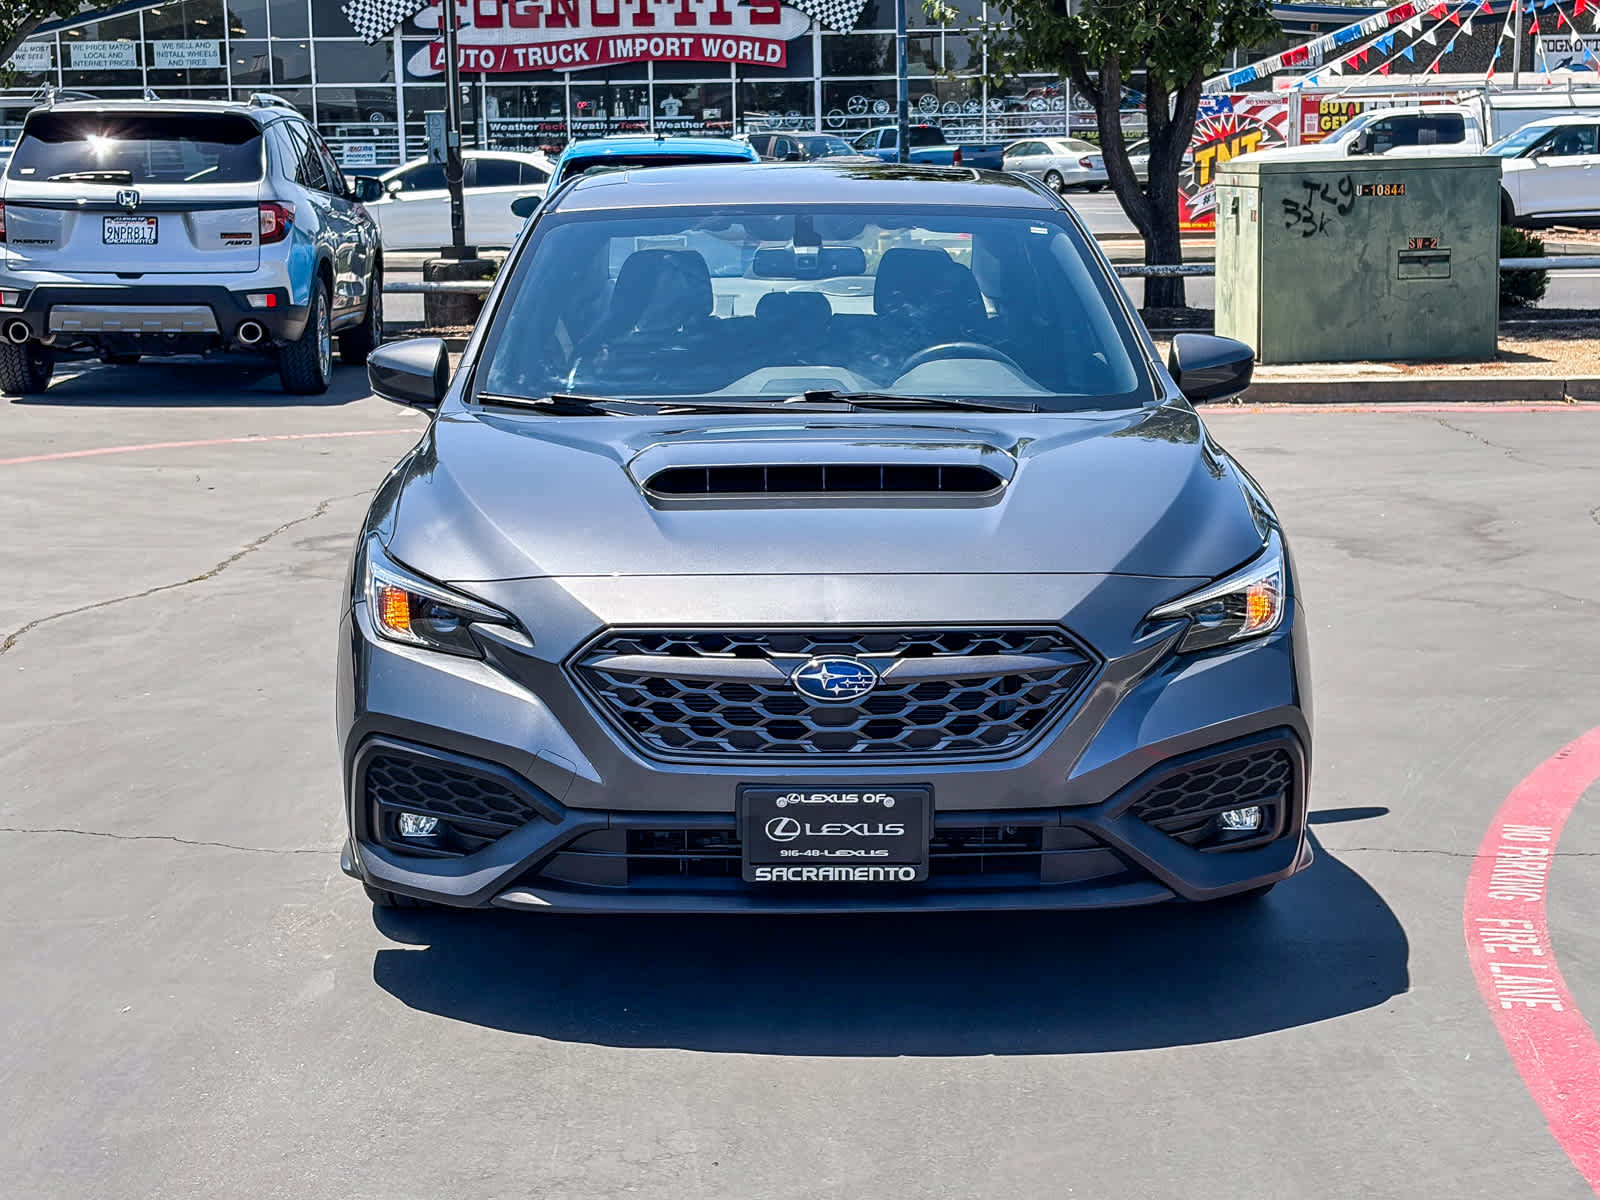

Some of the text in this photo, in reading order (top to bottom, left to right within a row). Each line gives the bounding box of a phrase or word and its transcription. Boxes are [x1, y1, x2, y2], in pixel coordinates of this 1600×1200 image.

[430, 0, 781, 29] OGNOTTIS
[108, 42, 134, 50] MATCH
[513, 42, 590, 67] TRUCK
[608, 38, 694, 59] IMPORT
[701, 38, 782, 63] WORLD
[1319, 102, 1349, 115] BUY
[1320, 116, 1348, 130] GET
[1195, 129, 1262, 186] TNT
[1356, 184, 1404, 196] U-10844
[106, 226, 154, 239] 9NPR817
[1408, 237, 1437, 249] SW-2
[801, 794, 887, 804] LEXUS OF
[805, 823, 905, 836] LEXUS
[755, 867, 916, 881] SACRAMENTO
[1474, 824, 1564, 1011] NO PARKING FIRE LANE
